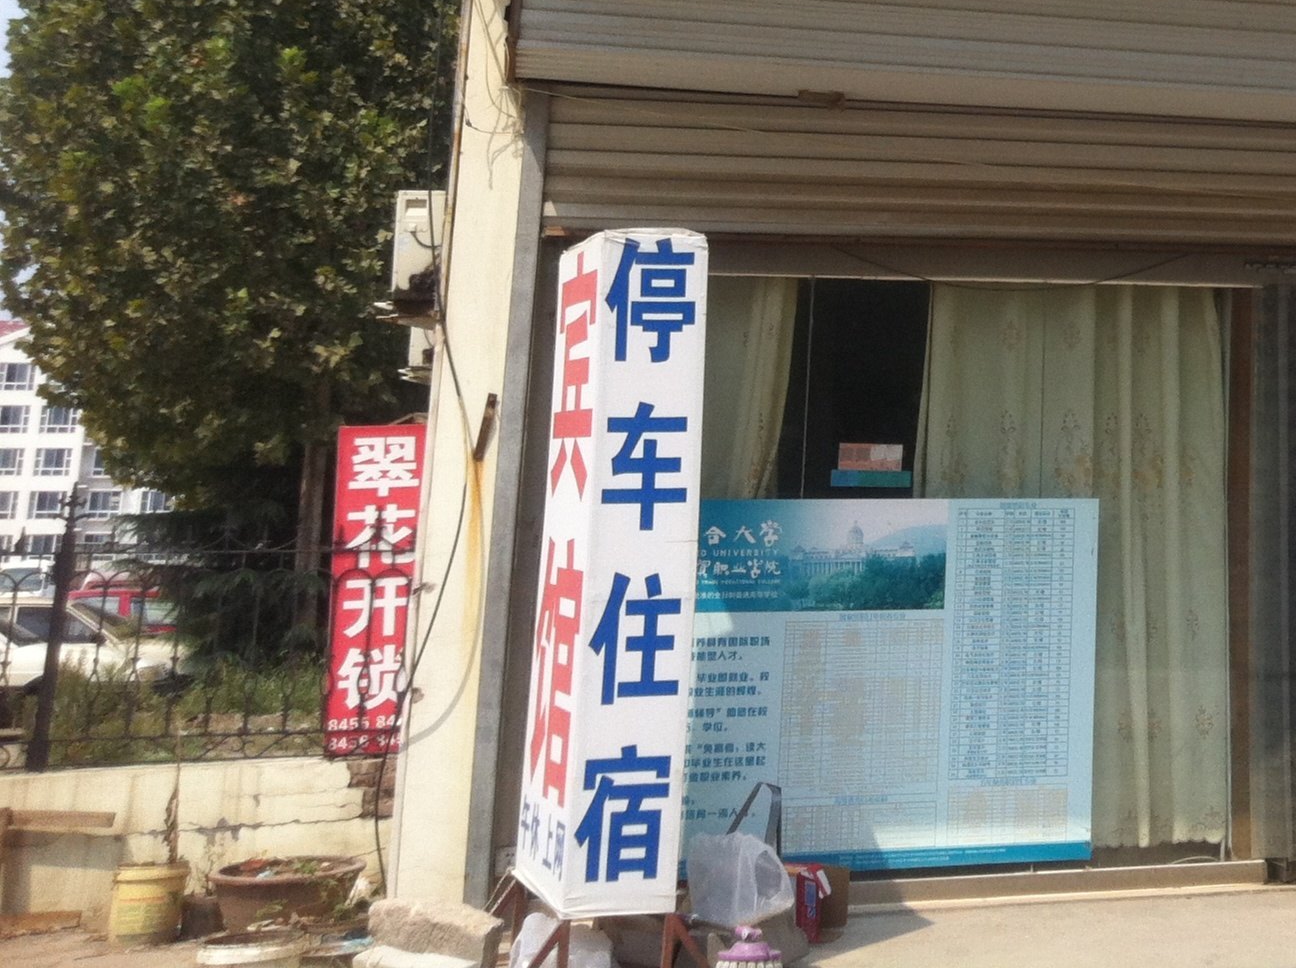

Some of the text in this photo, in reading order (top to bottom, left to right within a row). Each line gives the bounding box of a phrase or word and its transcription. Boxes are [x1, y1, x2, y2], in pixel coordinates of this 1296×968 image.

[337, 436, 420, 709] 翠花开锁
[530, 250, 598, 808] 宾馆
[574, 238, 696, 883] 停车住宿
